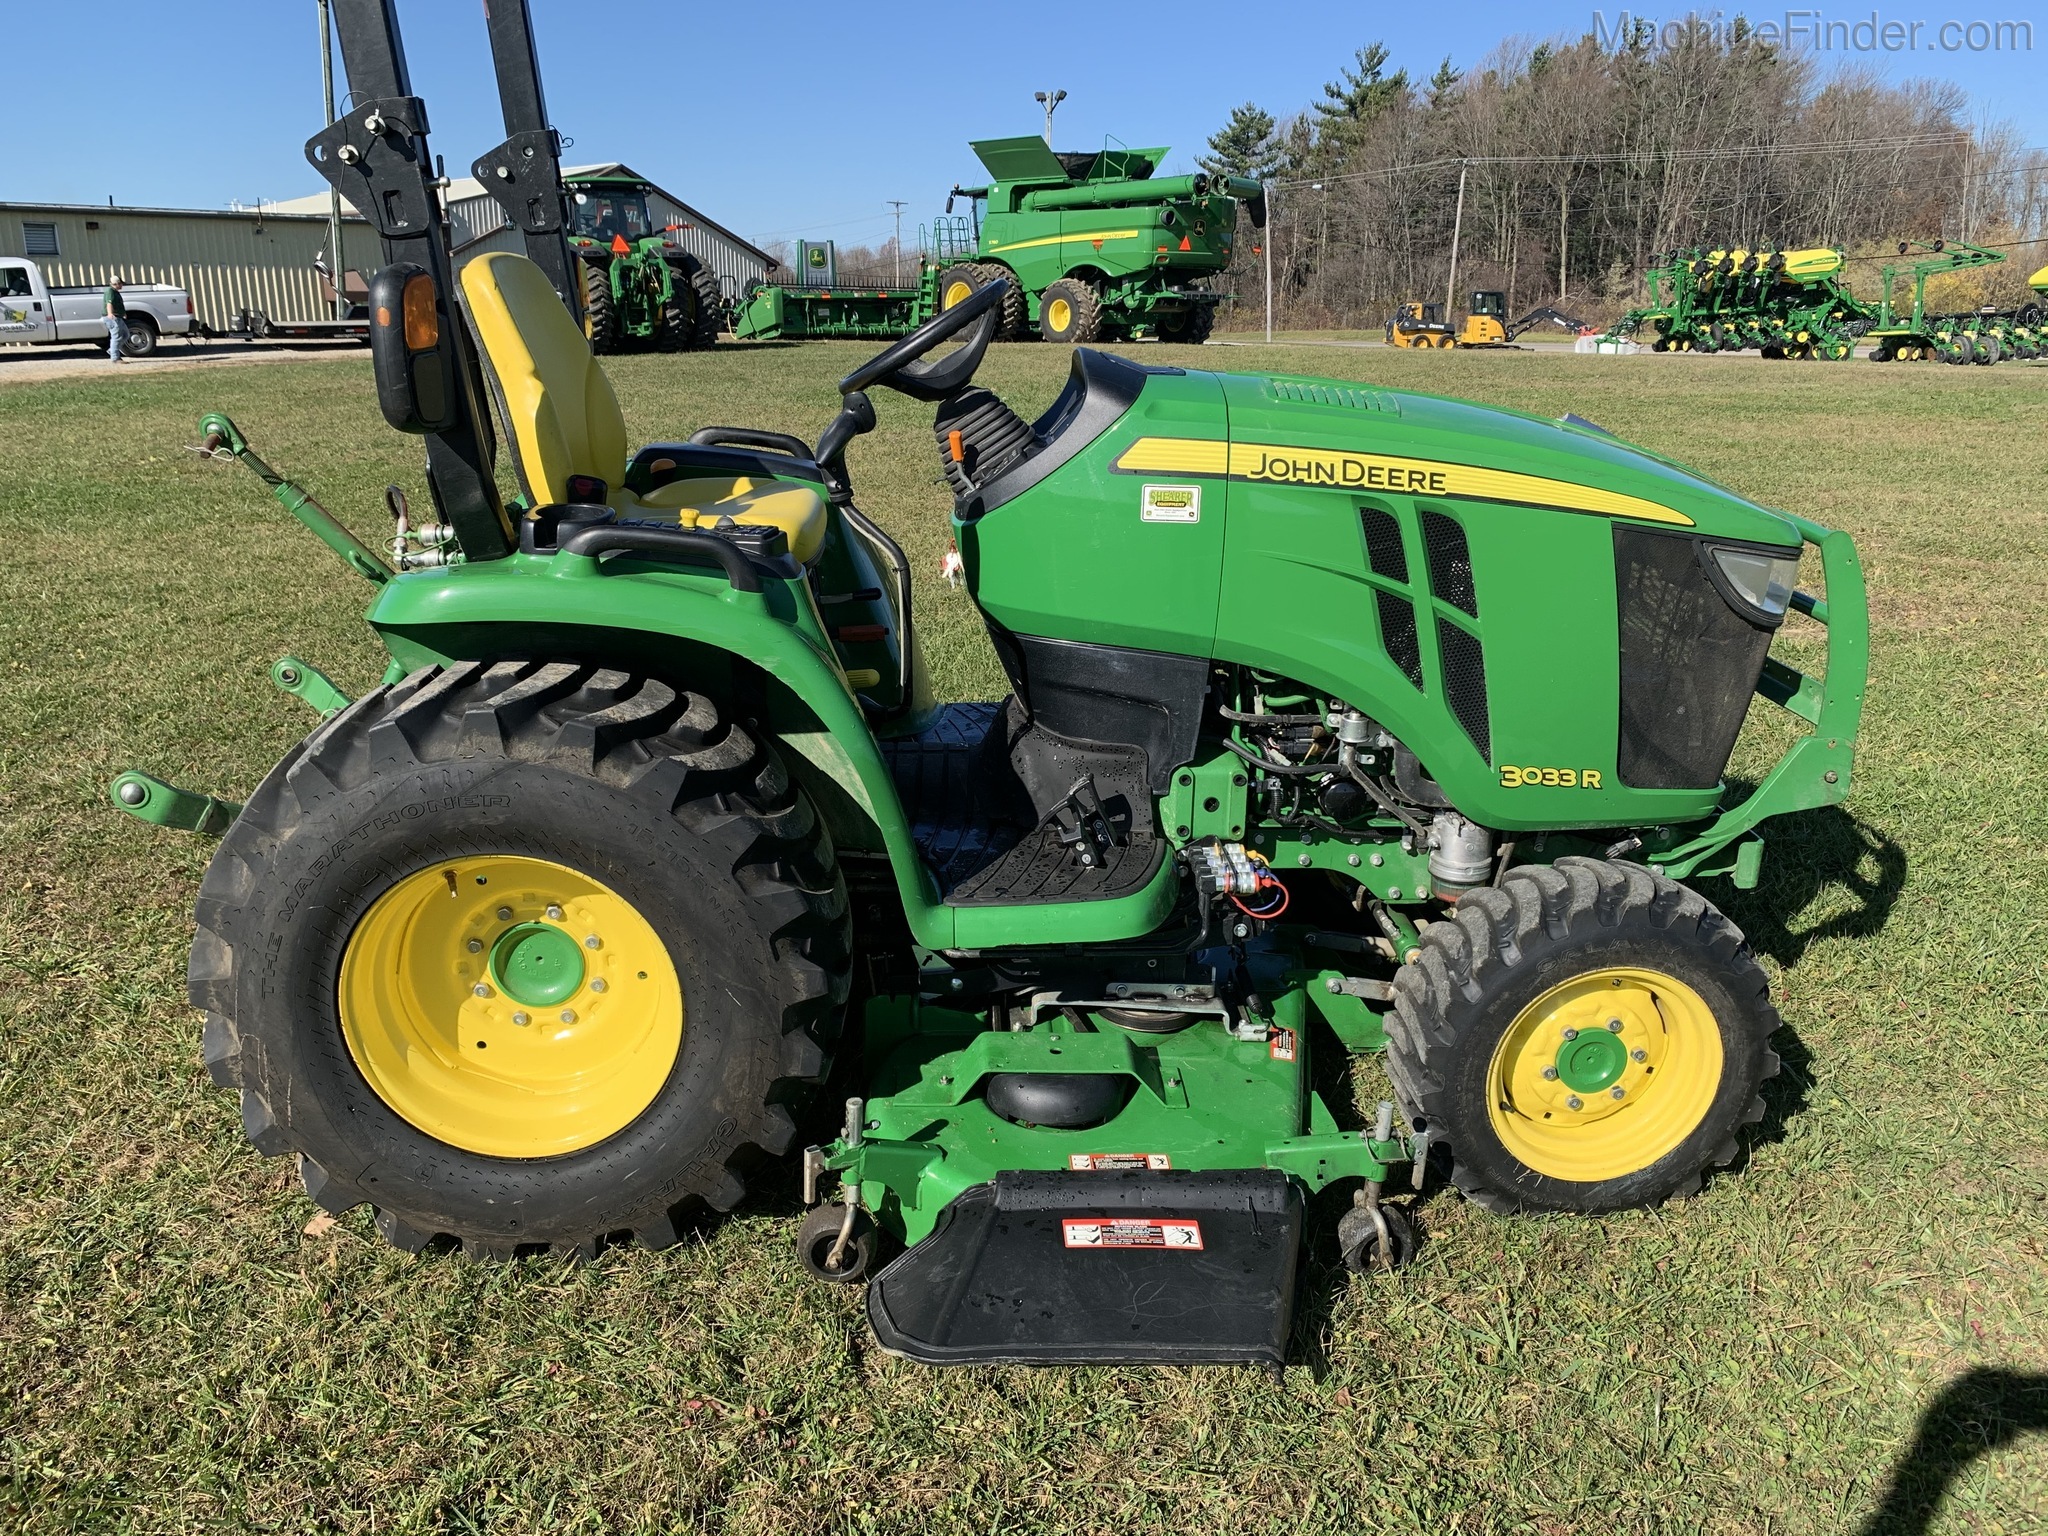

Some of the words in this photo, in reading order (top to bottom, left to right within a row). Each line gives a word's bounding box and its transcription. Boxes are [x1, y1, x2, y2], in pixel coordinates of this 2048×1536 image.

[1149, 490, 1194, 506] SHEARER
[1250, 453, 1335, 482] JOHN
[1342, 459, 1447, 492] DEERE
[261, 931, 284, 1000] THE
[277, 794, 512, 923] MARATHONER
[597, 1116, 738, 1226] GALAXY
